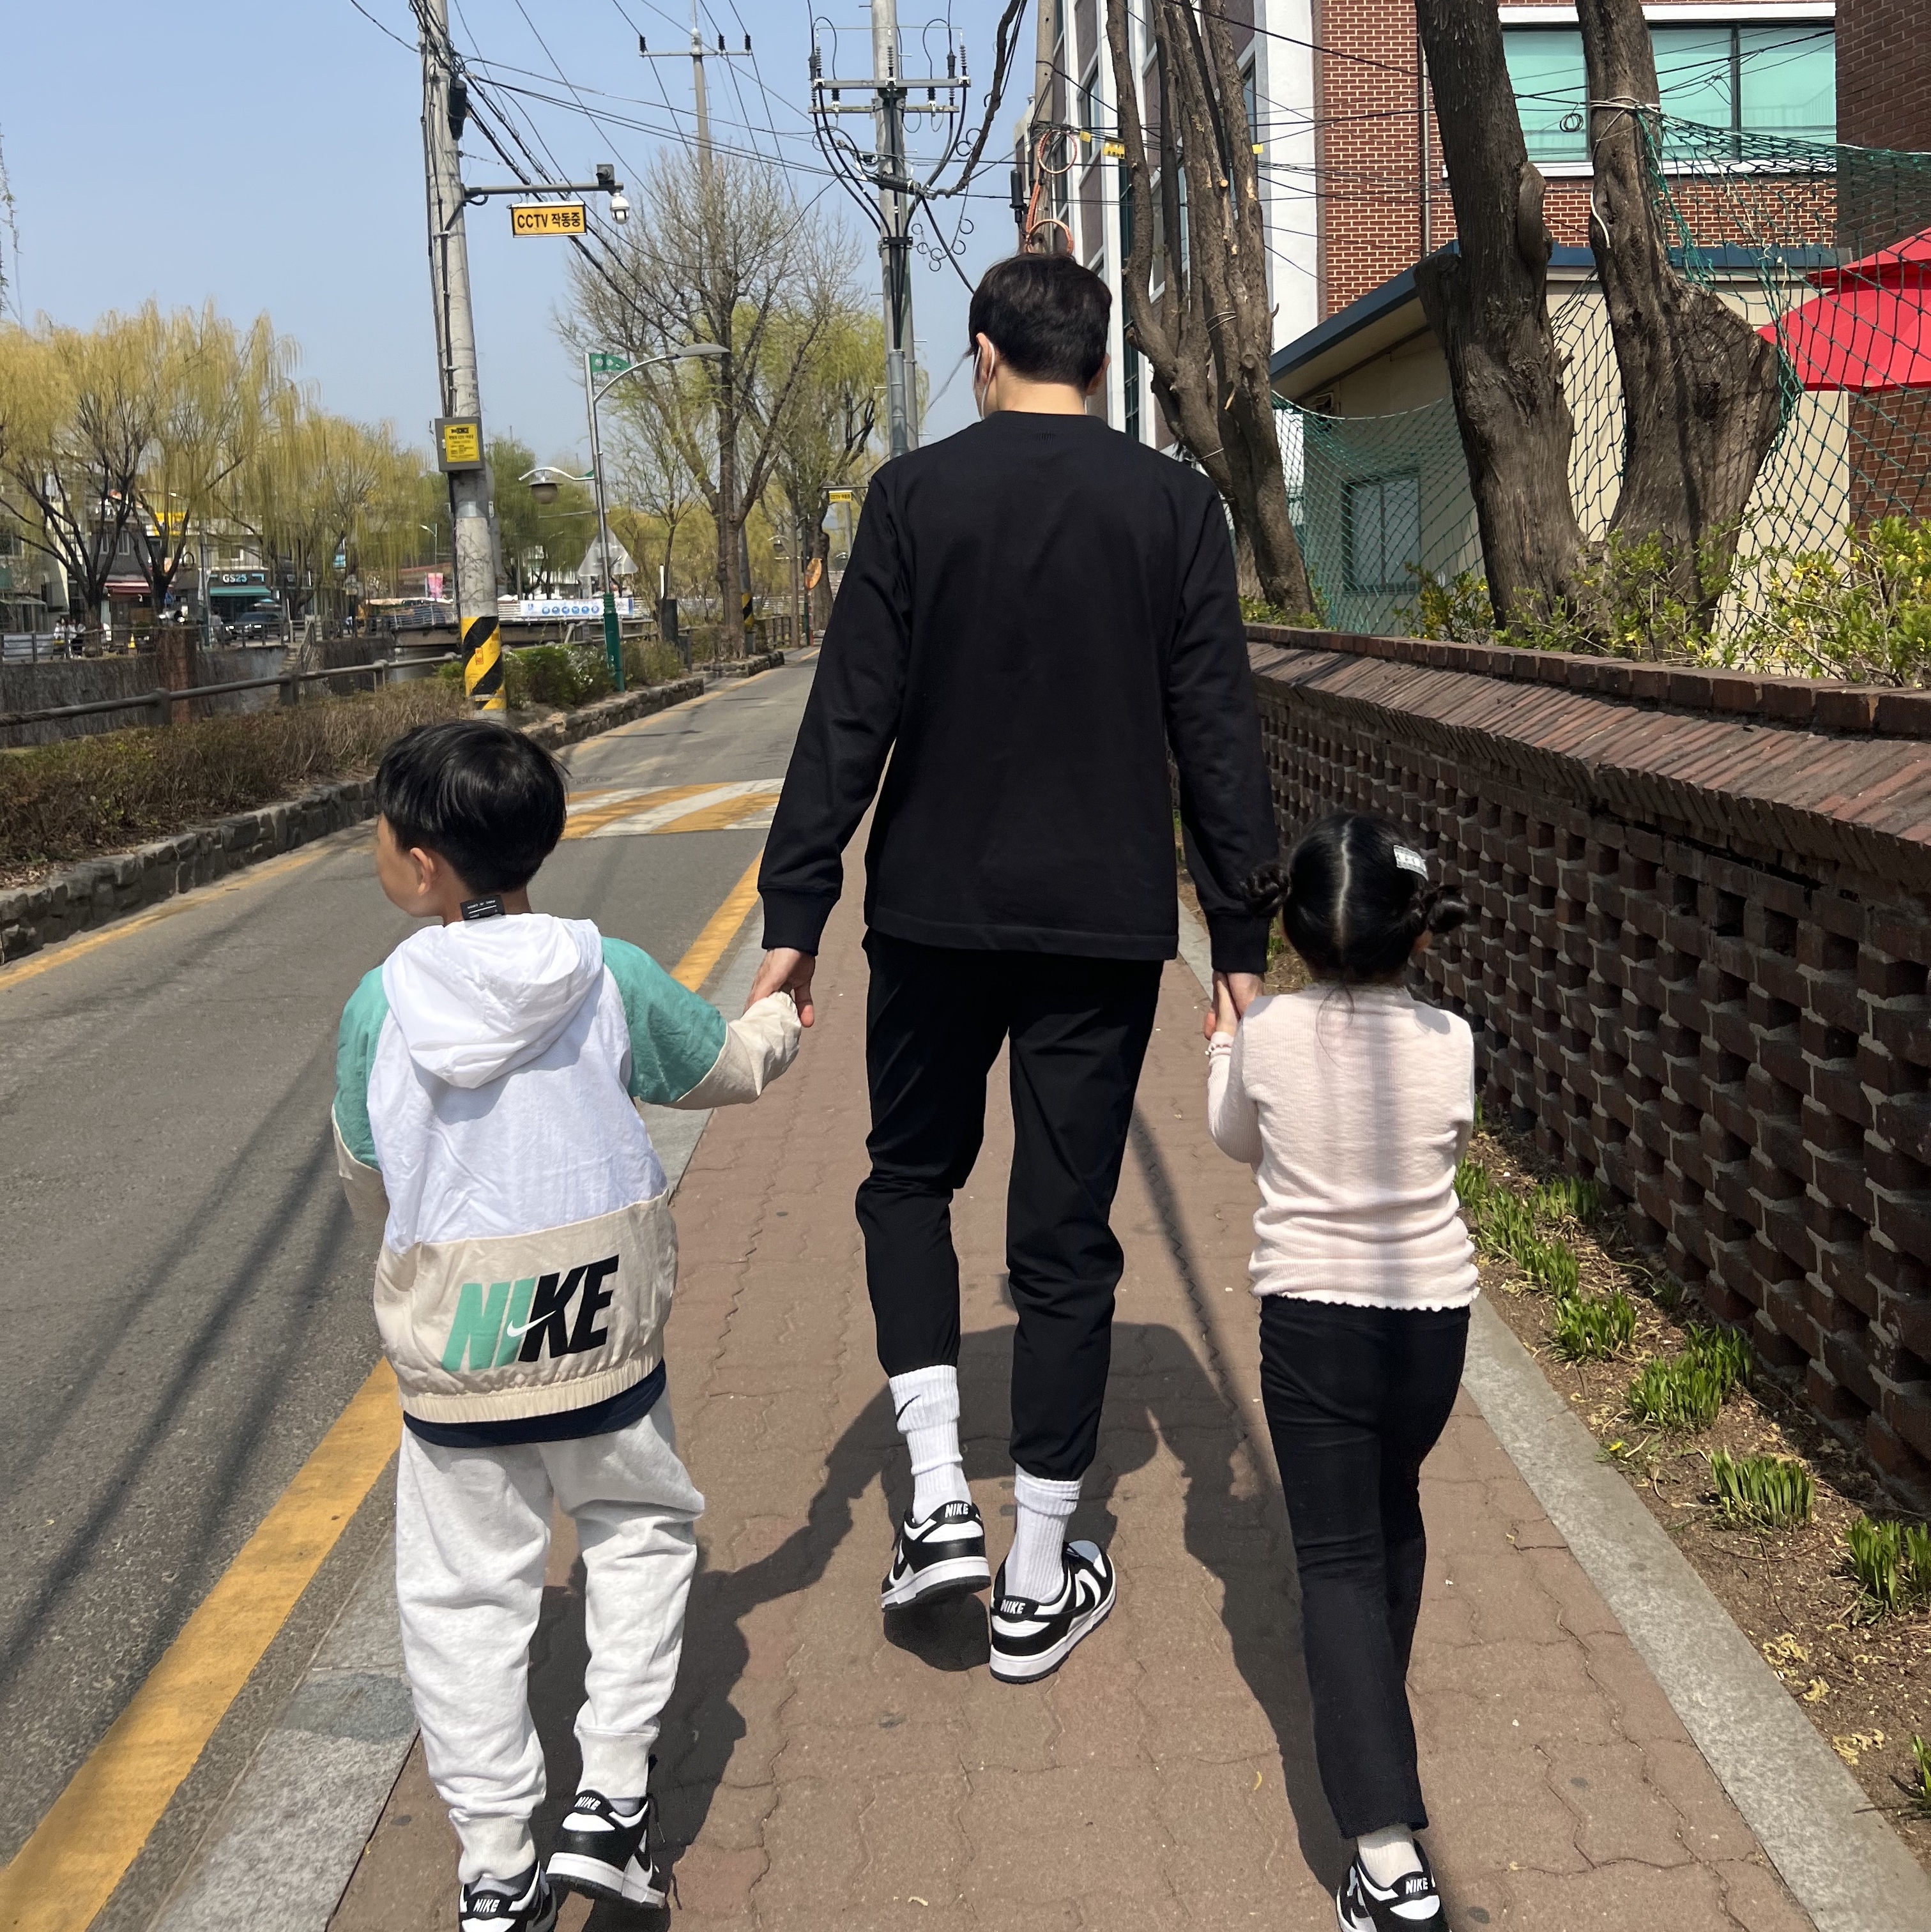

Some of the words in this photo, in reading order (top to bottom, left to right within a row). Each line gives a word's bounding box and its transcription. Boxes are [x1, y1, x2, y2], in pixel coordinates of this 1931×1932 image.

[517, 213, 548, 228] CCTV
[551, 211, 581, 227] 작동중
[222, 574, 247, 583] GS25
[441, 1254, 620, 1371] NIKE
[945, 1503, 969, 1518] NIKE
[1000, 1599, 1026, 1615] NIKE
[574, 1796, 601, 1811] NIKE
[1405, 1877, 1428, 1894] NIKE
[473, 1899, 500, 1913] NIKE
